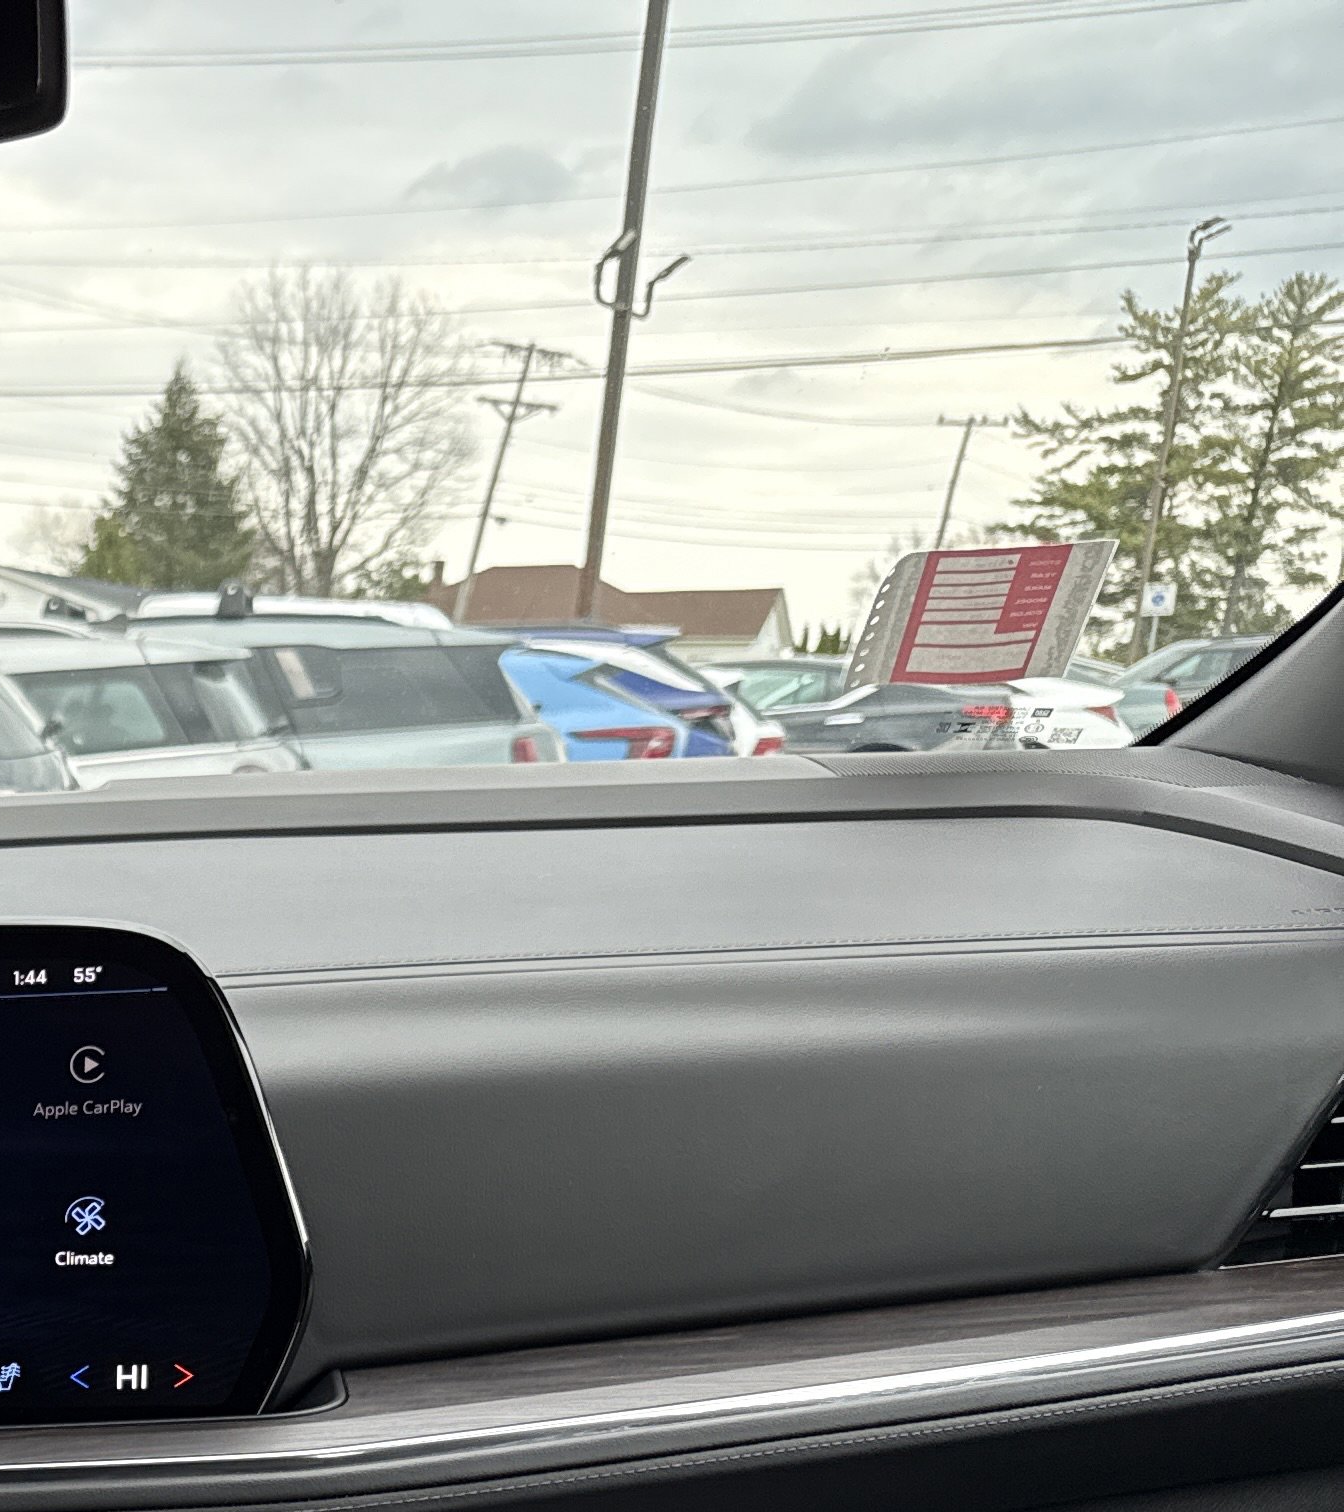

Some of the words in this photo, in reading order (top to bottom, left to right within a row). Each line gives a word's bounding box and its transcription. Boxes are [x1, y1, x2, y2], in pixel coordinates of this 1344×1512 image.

[13, 970, 47, 987] 1:44
[73, 966, 103, 983] 55°
[32, 1101, 78, 1119] Apple
[81, 1099, 142, 1118] CarPlay
[54, 1249, 114, 1266] Climate
[116, 1365, 148, 1391] HI
